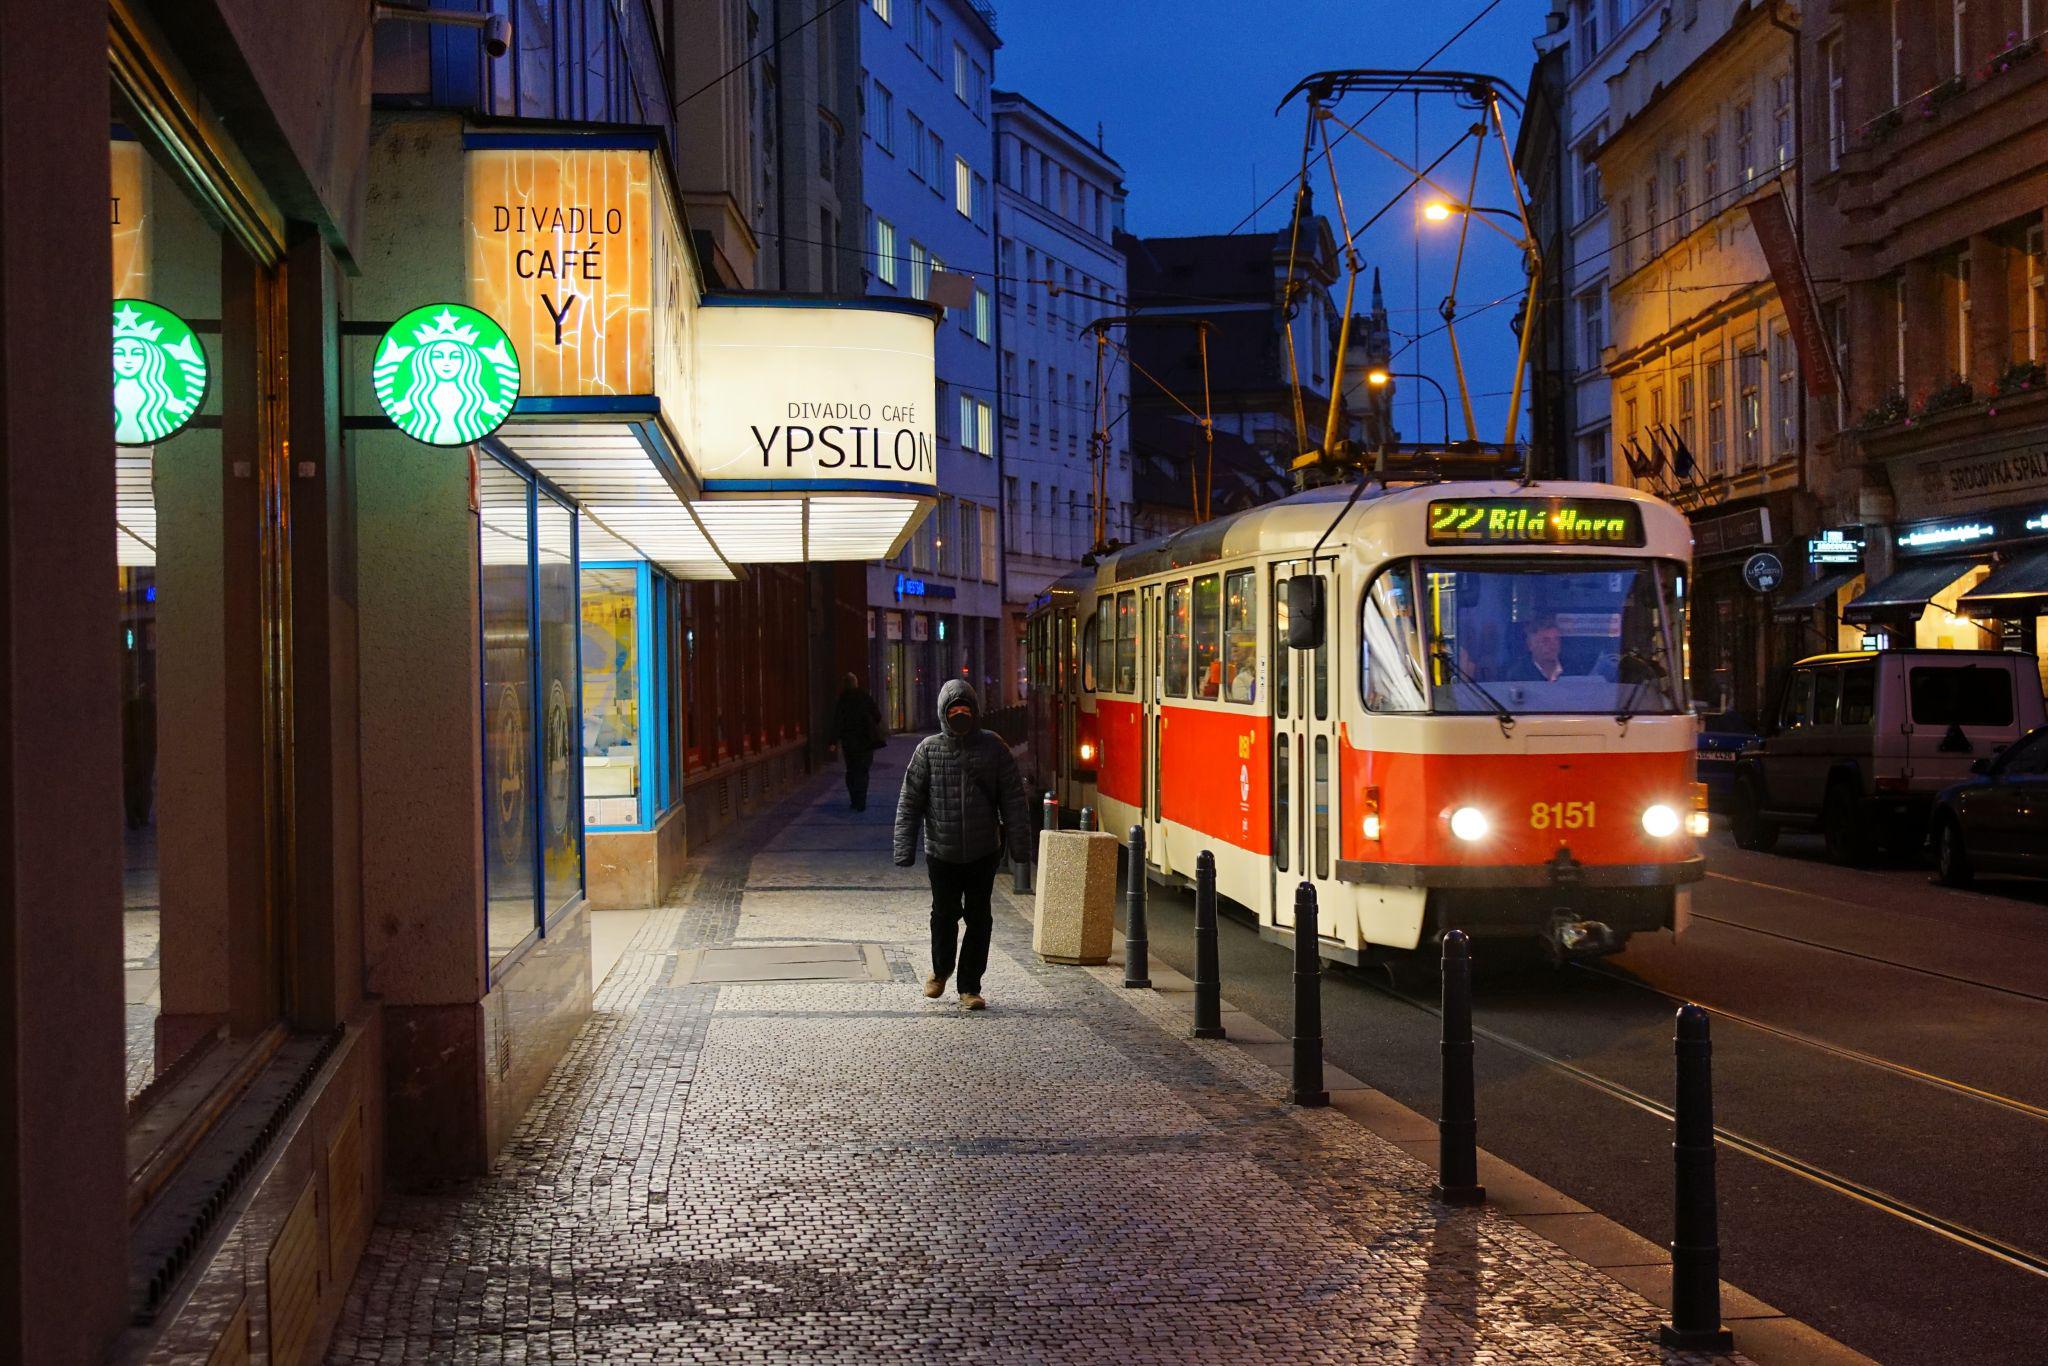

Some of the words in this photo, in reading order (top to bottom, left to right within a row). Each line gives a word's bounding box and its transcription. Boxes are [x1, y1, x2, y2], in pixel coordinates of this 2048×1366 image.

[493, 205, 622, 235] DIVADLO
[515, 242, 602, 280] CAFÉ
[540, 293, 577, 346] Y
[787, 402, 872, 421] DIVADLO
[881, 402, 916, 424] CAFÉ
[750, 424, 933, 474] YPSILON
[1431, 508, 1485, 538] 22
[1556, 509, 1625, 537] Hora
[1529, 801, 1596, 830] 8151
